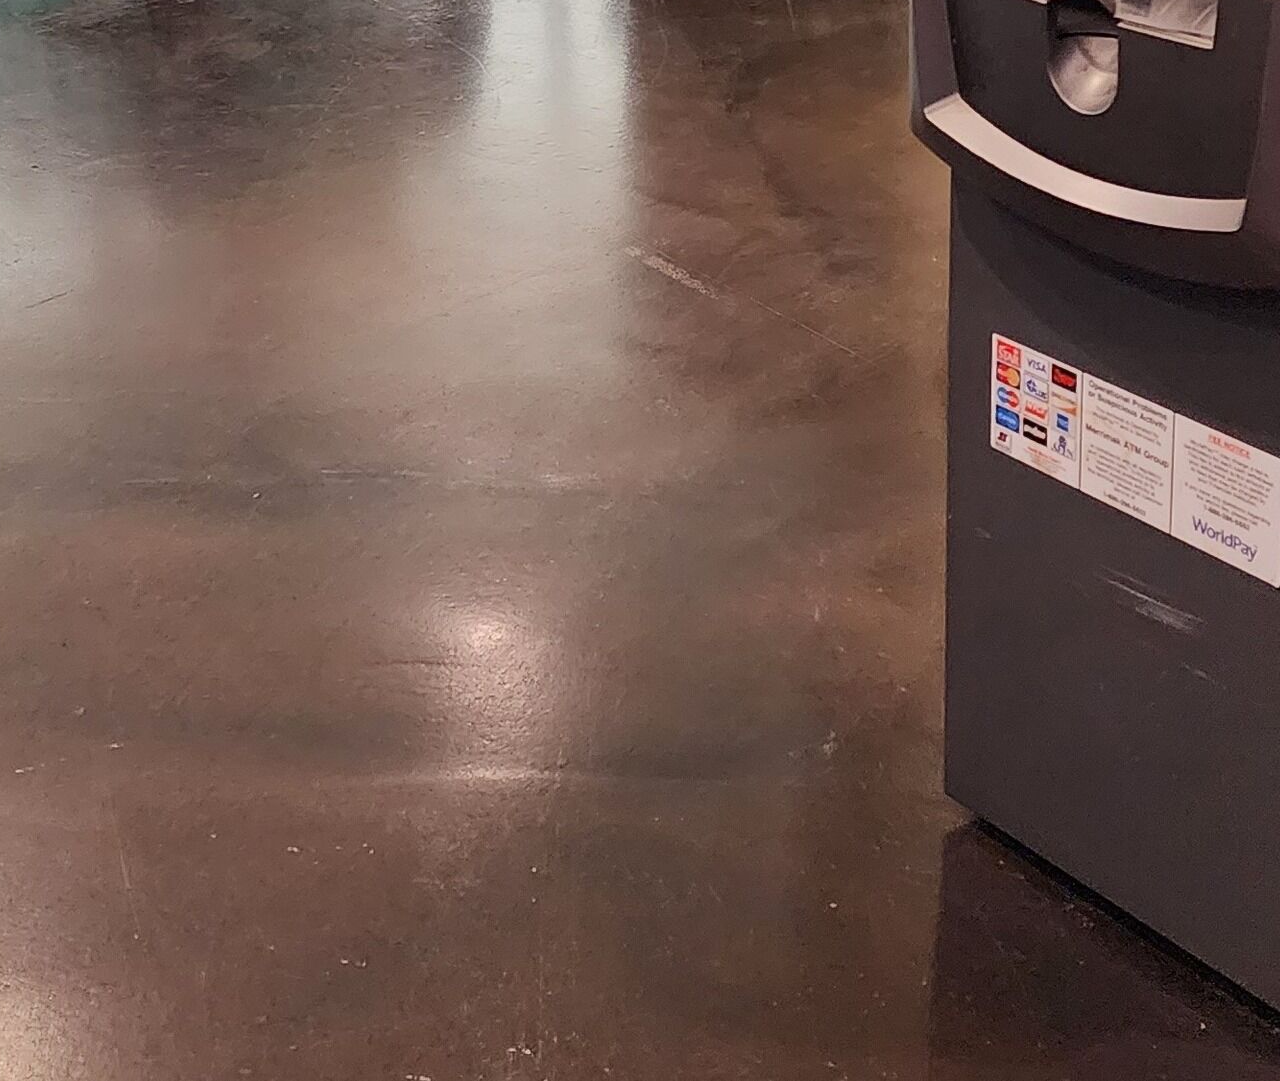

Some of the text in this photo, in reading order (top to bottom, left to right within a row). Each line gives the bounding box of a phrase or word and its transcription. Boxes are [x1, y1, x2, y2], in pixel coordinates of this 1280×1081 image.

[1027, 358, 1047, 373] VISA
[1089, 380, 1130, 403] Operational
[1132, 399, 1167, 420] Problems
[1140, 413, 1167, 432] Activity
[1123, 441, 1141, 455] ATM
[1143, 450, 1169, 469] Group
[1192, 515, 1258, 562] WorldPay
